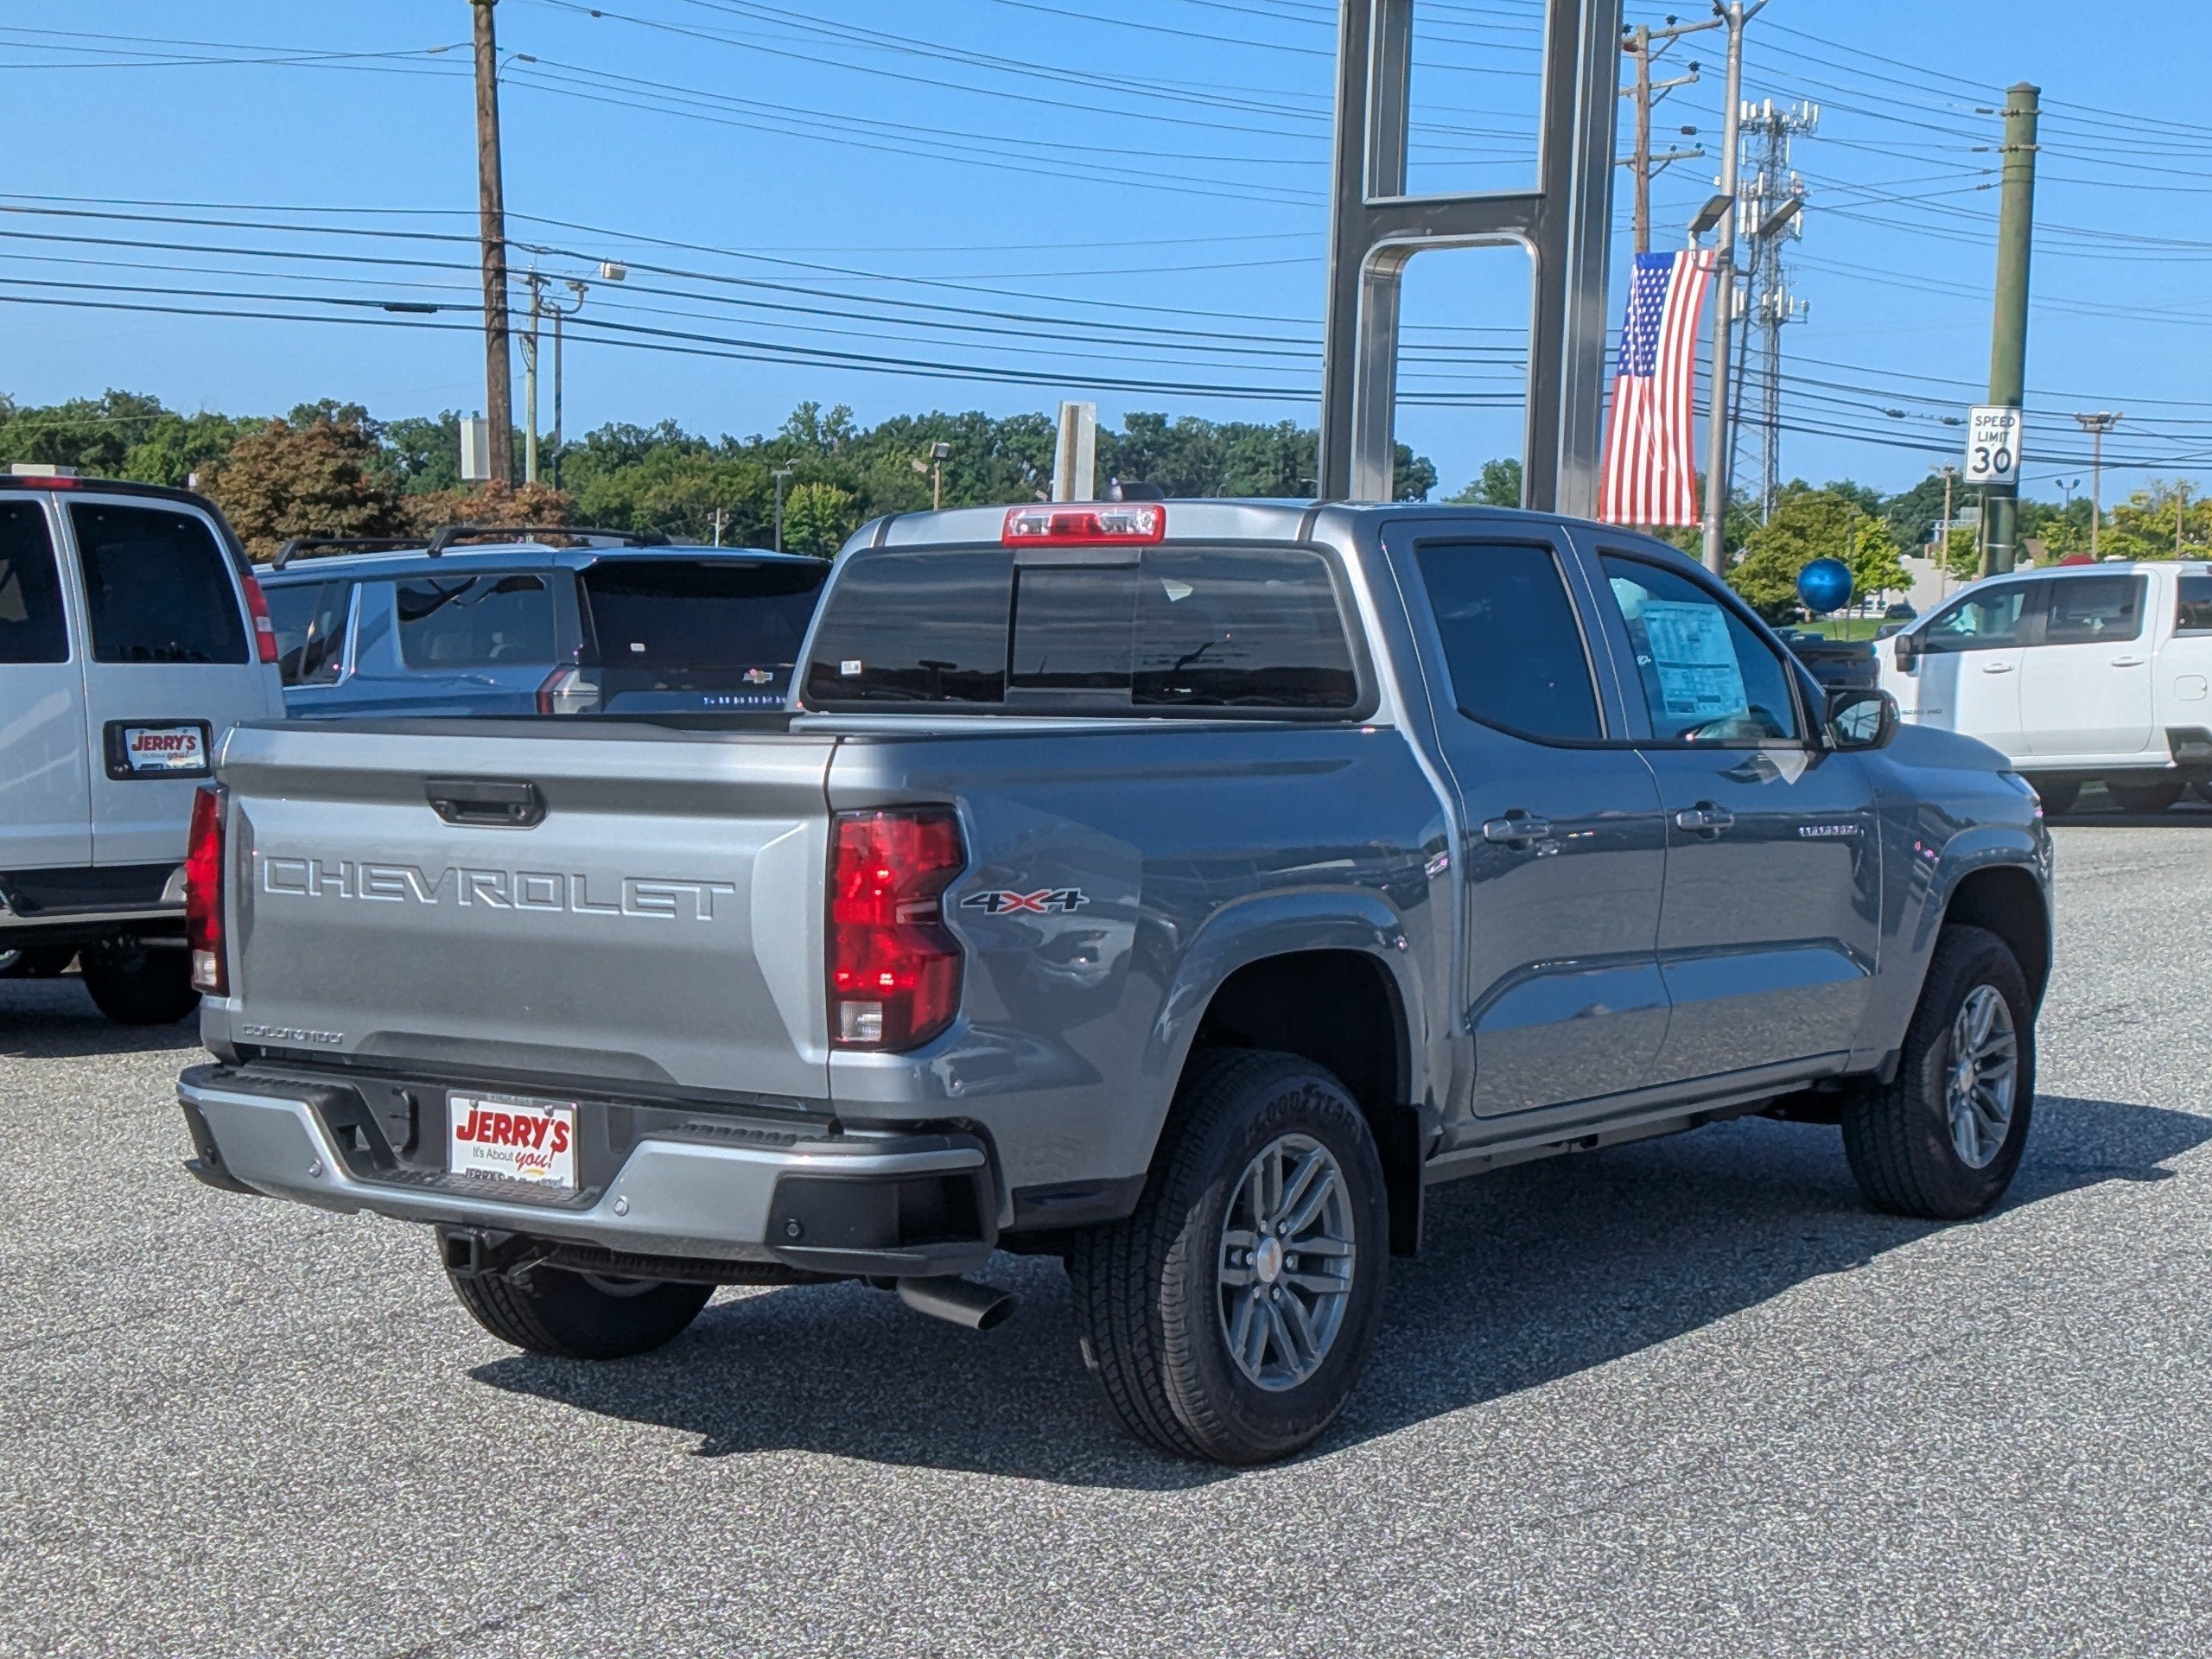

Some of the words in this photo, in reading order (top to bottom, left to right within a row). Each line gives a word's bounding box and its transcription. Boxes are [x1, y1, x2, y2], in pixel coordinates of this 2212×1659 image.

[1975, 416, 2015, 427] SPEED
[1978, 431, 2009, 442] LIMIT
[1972, 446, 2012, 474] 30
[131, 734, 197, 752] JERRY'S
[264, 856, 735, 921] CHEVROLET
[243, 1025, 343, 1044] COLORADO
[456, 1109, 570, 1153] JERRY'S
[473, 1147, 485, 1159] It's
[486, 1148, 514, 1162] About
[515, 1150, 555, 1172] you!
